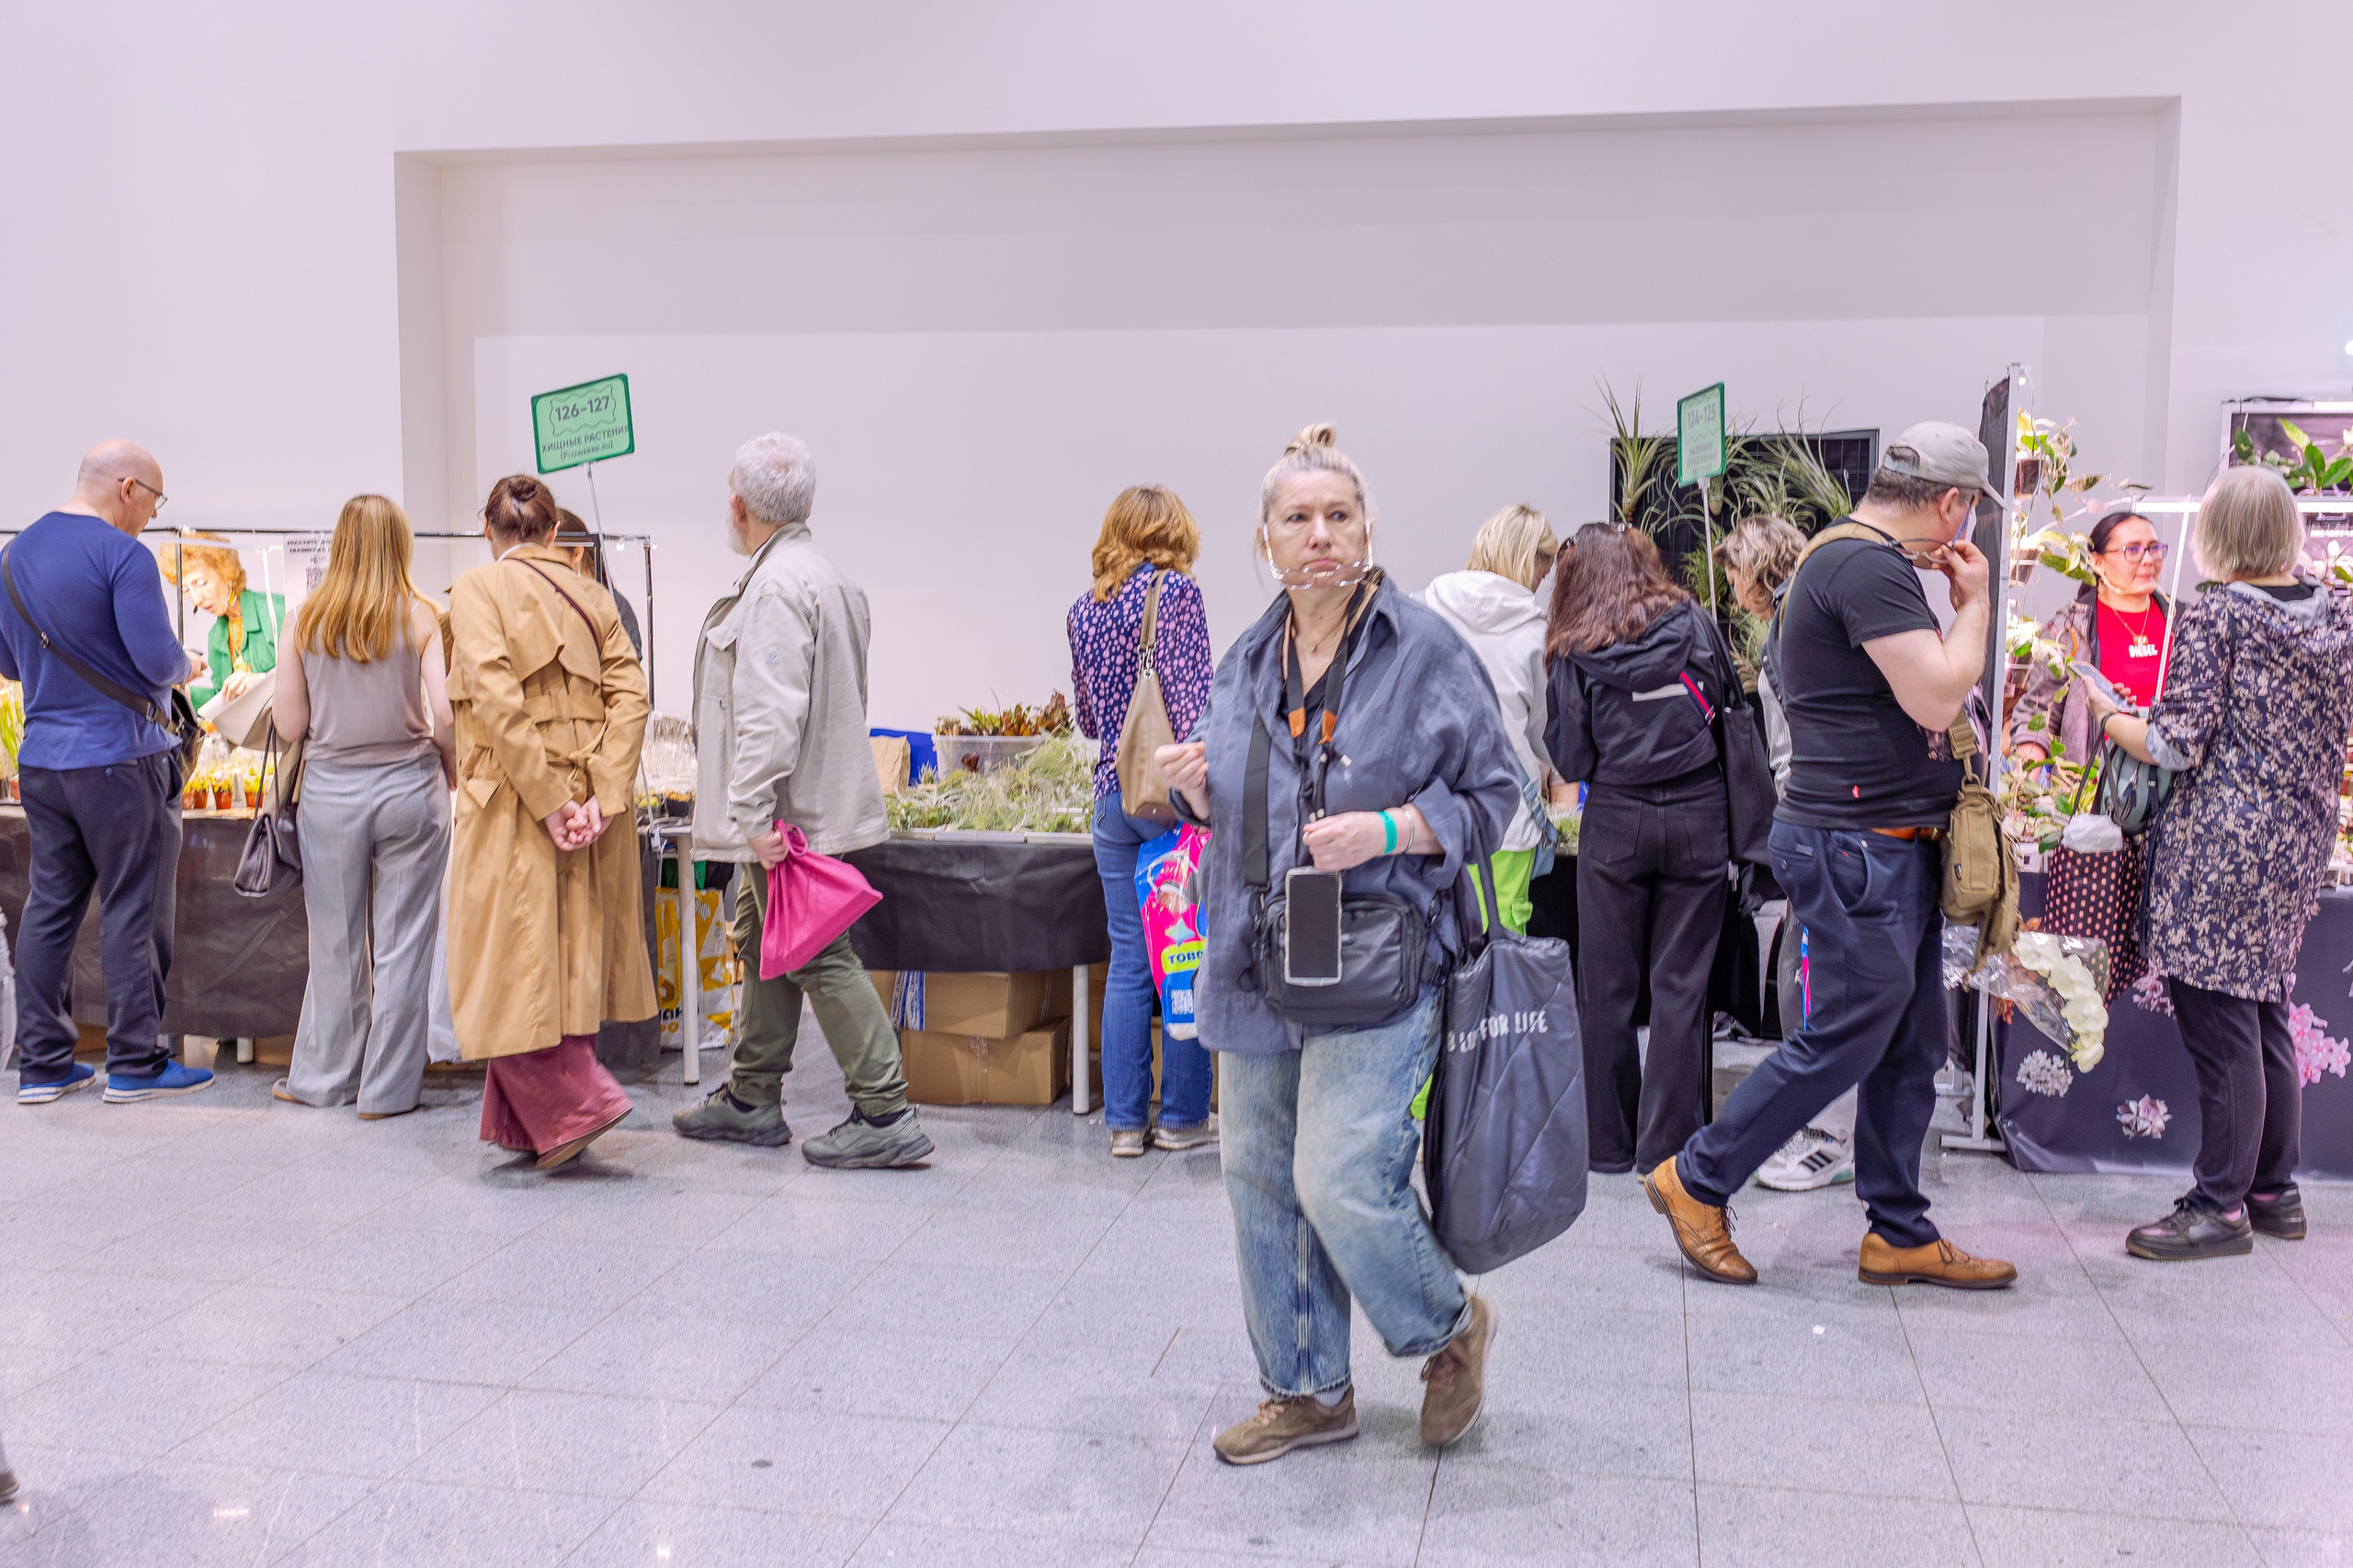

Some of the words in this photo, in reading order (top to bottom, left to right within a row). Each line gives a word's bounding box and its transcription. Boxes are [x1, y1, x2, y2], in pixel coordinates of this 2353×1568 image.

[555, 395, 610, 422] 126-127
[1688, 403, 1716, 430] 124-125
[541, 435, 582, 454] ХИЩНЫЕ
[1479, 1013, 1509, 1040] FOR
[1514, 1010, 1549, 1034] LIFE
